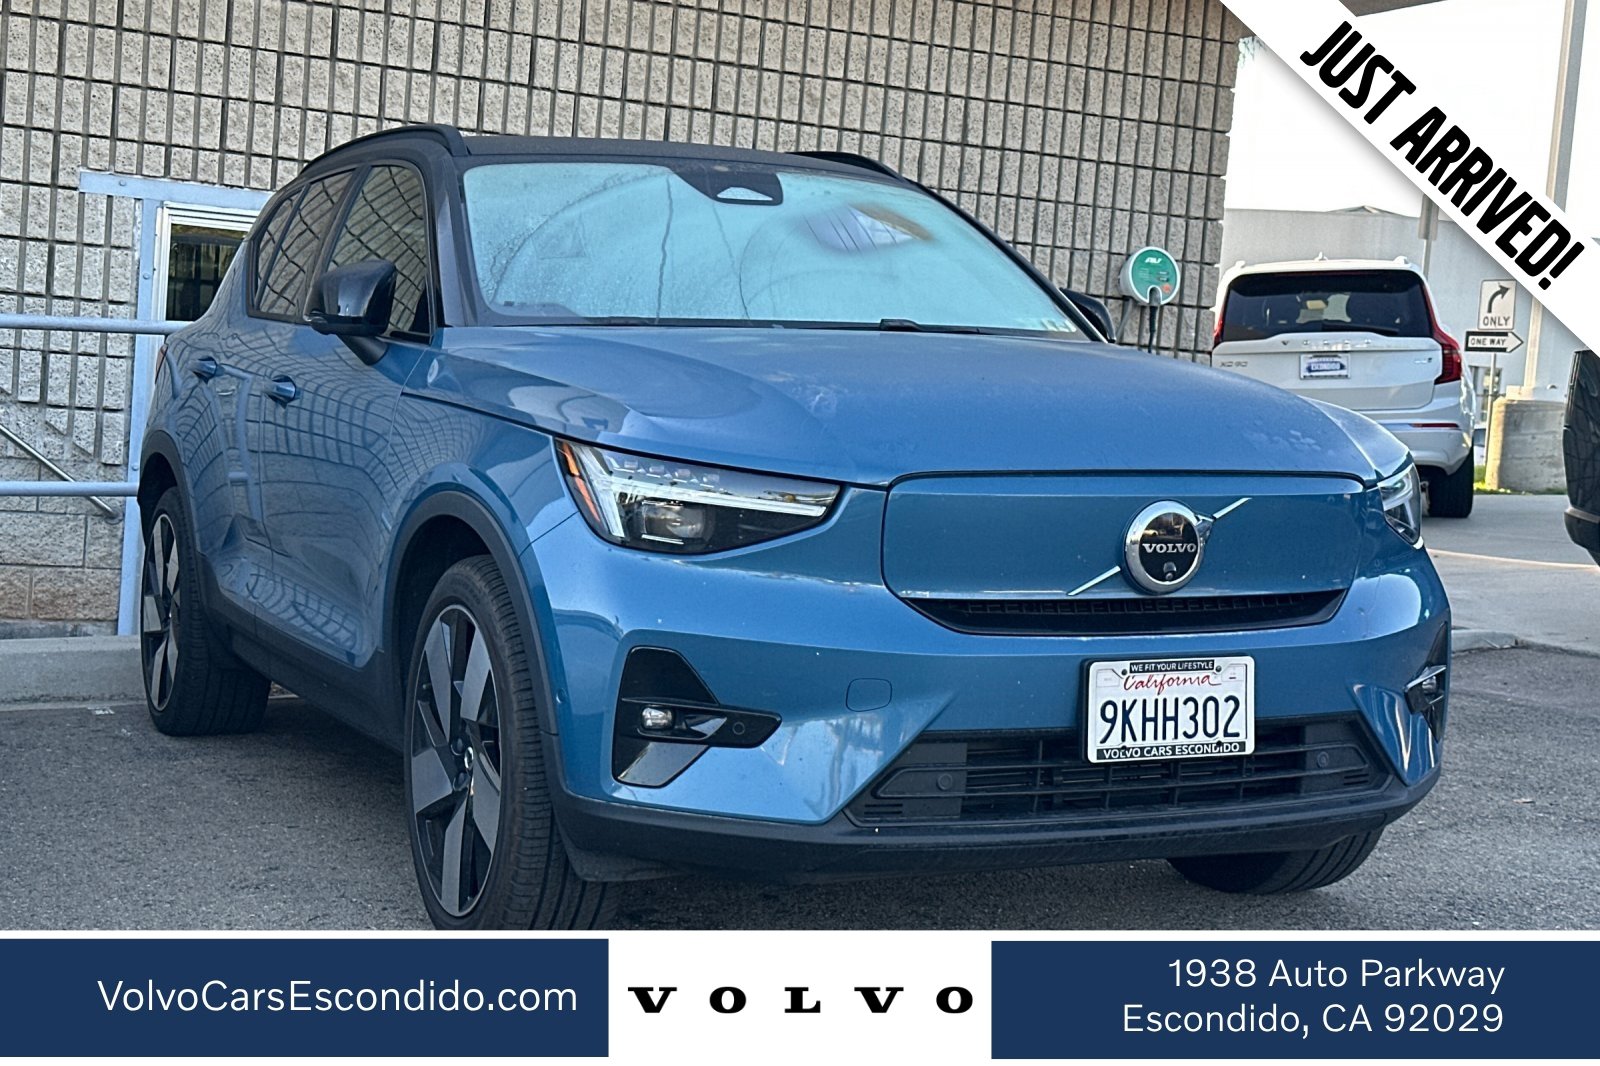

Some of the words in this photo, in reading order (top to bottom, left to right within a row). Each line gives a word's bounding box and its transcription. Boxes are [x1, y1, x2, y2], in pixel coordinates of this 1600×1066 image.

[1482, 316, 1510, 327] ONLY
[1470, 337, 1487, 346] ONE
[1489, 338, 1506, 346] WAY
[1142, 543, 1197, 553] VOLVO
[1130, 663, 1143, 671] WE
[1156, 662, 1176, 671] YOUR
[1177, 661, 1213, 669] LIFESTYLE
[1123, 673, 1222, 696] California
[1099, 695, 1240, 744] 9KHH302
[1103, 748, 1141, 759] VOLVO
[1143, 745, 1173, 756] CARS
[1175, 742, 1240, 755] ESCONDIDO
